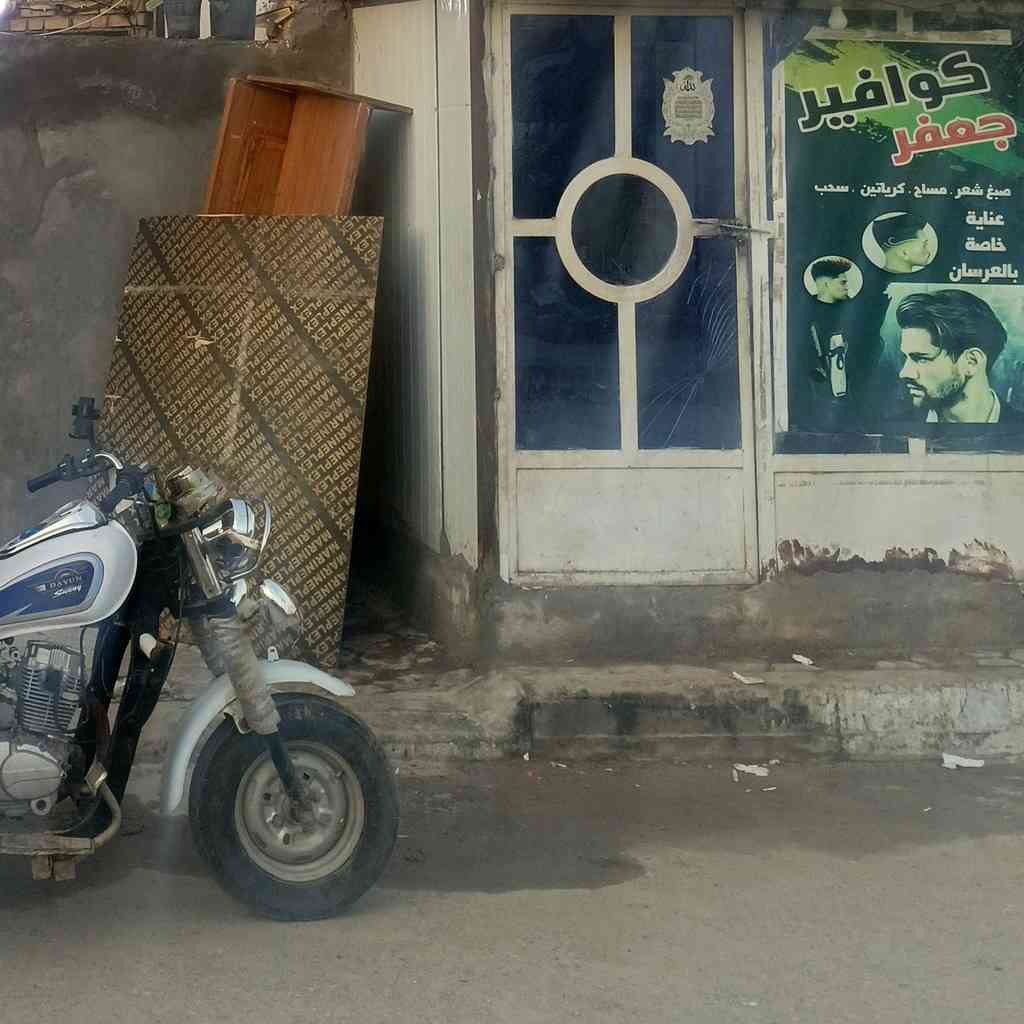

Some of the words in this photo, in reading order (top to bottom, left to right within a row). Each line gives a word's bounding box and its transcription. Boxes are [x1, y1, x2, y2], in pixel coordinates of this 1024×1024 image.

[797, 50, 992, 133] كوافير
[891, 112, 1018, 167] جعفر
[814, 183, 849, 196] سحب
[954, 182, 985, 199] شعر
[986, 183, 1012, 200] صبغ
[965, 210, 1005, 231] عناية
[964, 236, 1008, 252] خاصة
[948, 262, 1019, 284] بالعرسان
